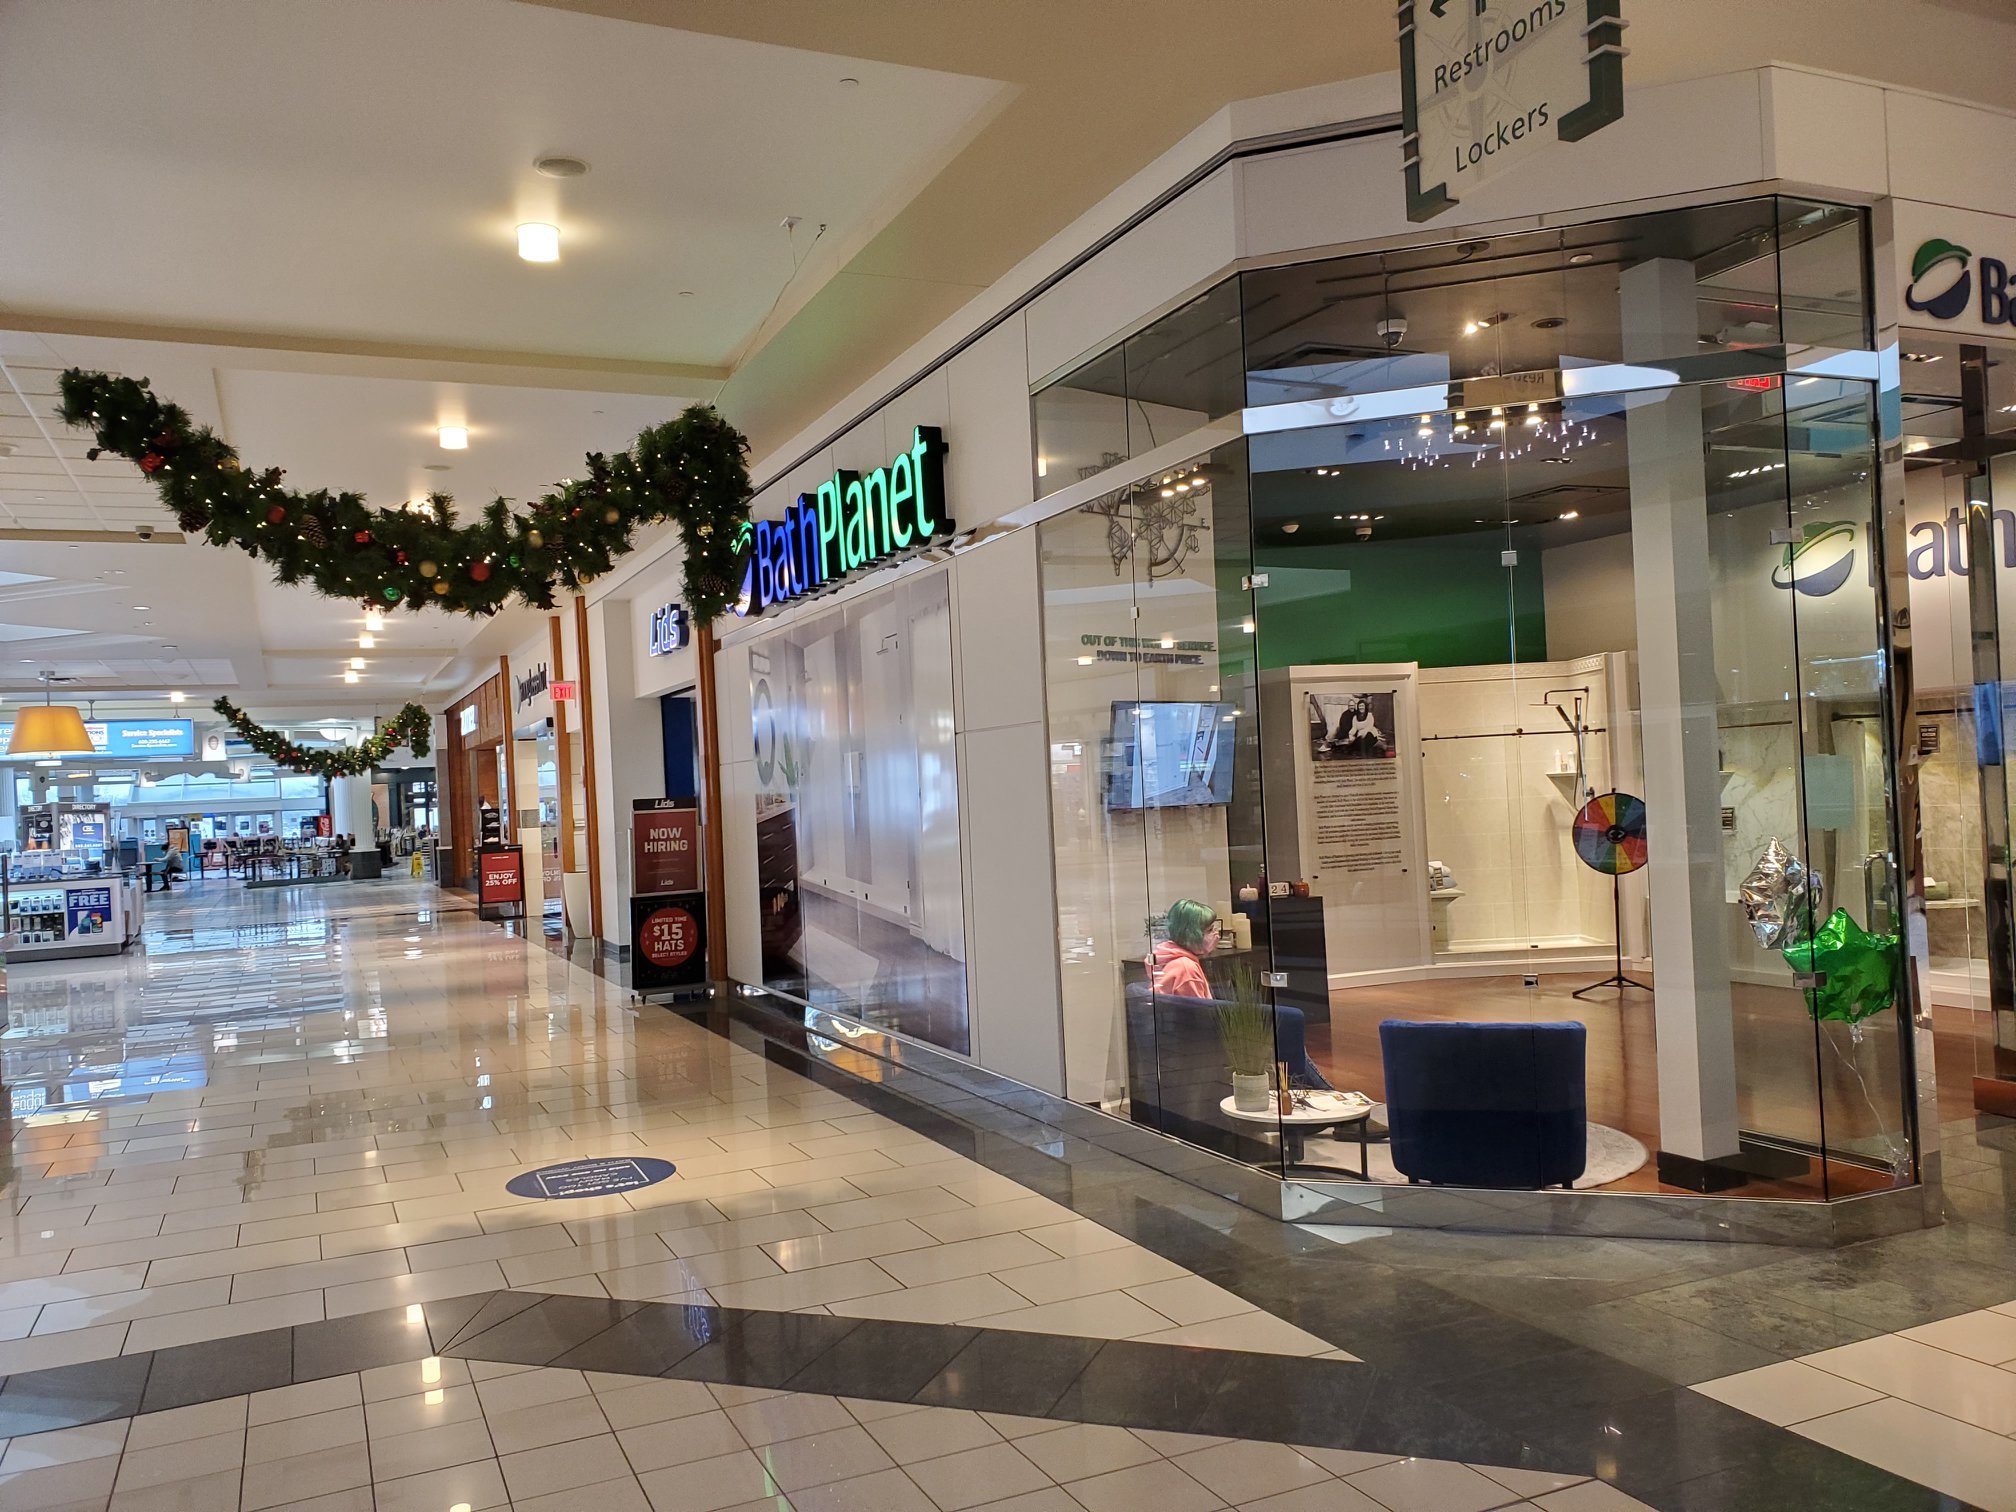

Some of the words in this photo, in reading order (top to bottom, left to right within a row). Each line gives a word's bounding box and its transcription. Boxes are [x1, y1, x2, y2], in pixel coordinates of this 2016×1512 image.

[1434, 0, 1566, 93] Restrooms
[1456, 102, 1549, 173] Lockers
[650, 603, 683, 656] Lids
[1081, 634, 1102, 647] OUT
[1103, 636, 1118, 647] OF
[1119, 637, 1141, 647] THIS
[1096, 650, 1127, 662] DOWN
[1128, 652, 1142, 662] TO
[1143, 653, 1174, 664] EARTH
[553, 685, 572, 699] EXIT
[655, 799, 675, 808] Lids
[650, 827, 682, 839] NOW
[645, 840, 688, 853] HIRING
[69, 894, 109, 907] FREE
[653, 923, 683, 940] $15
[654, 940, 685, 951] HATS
